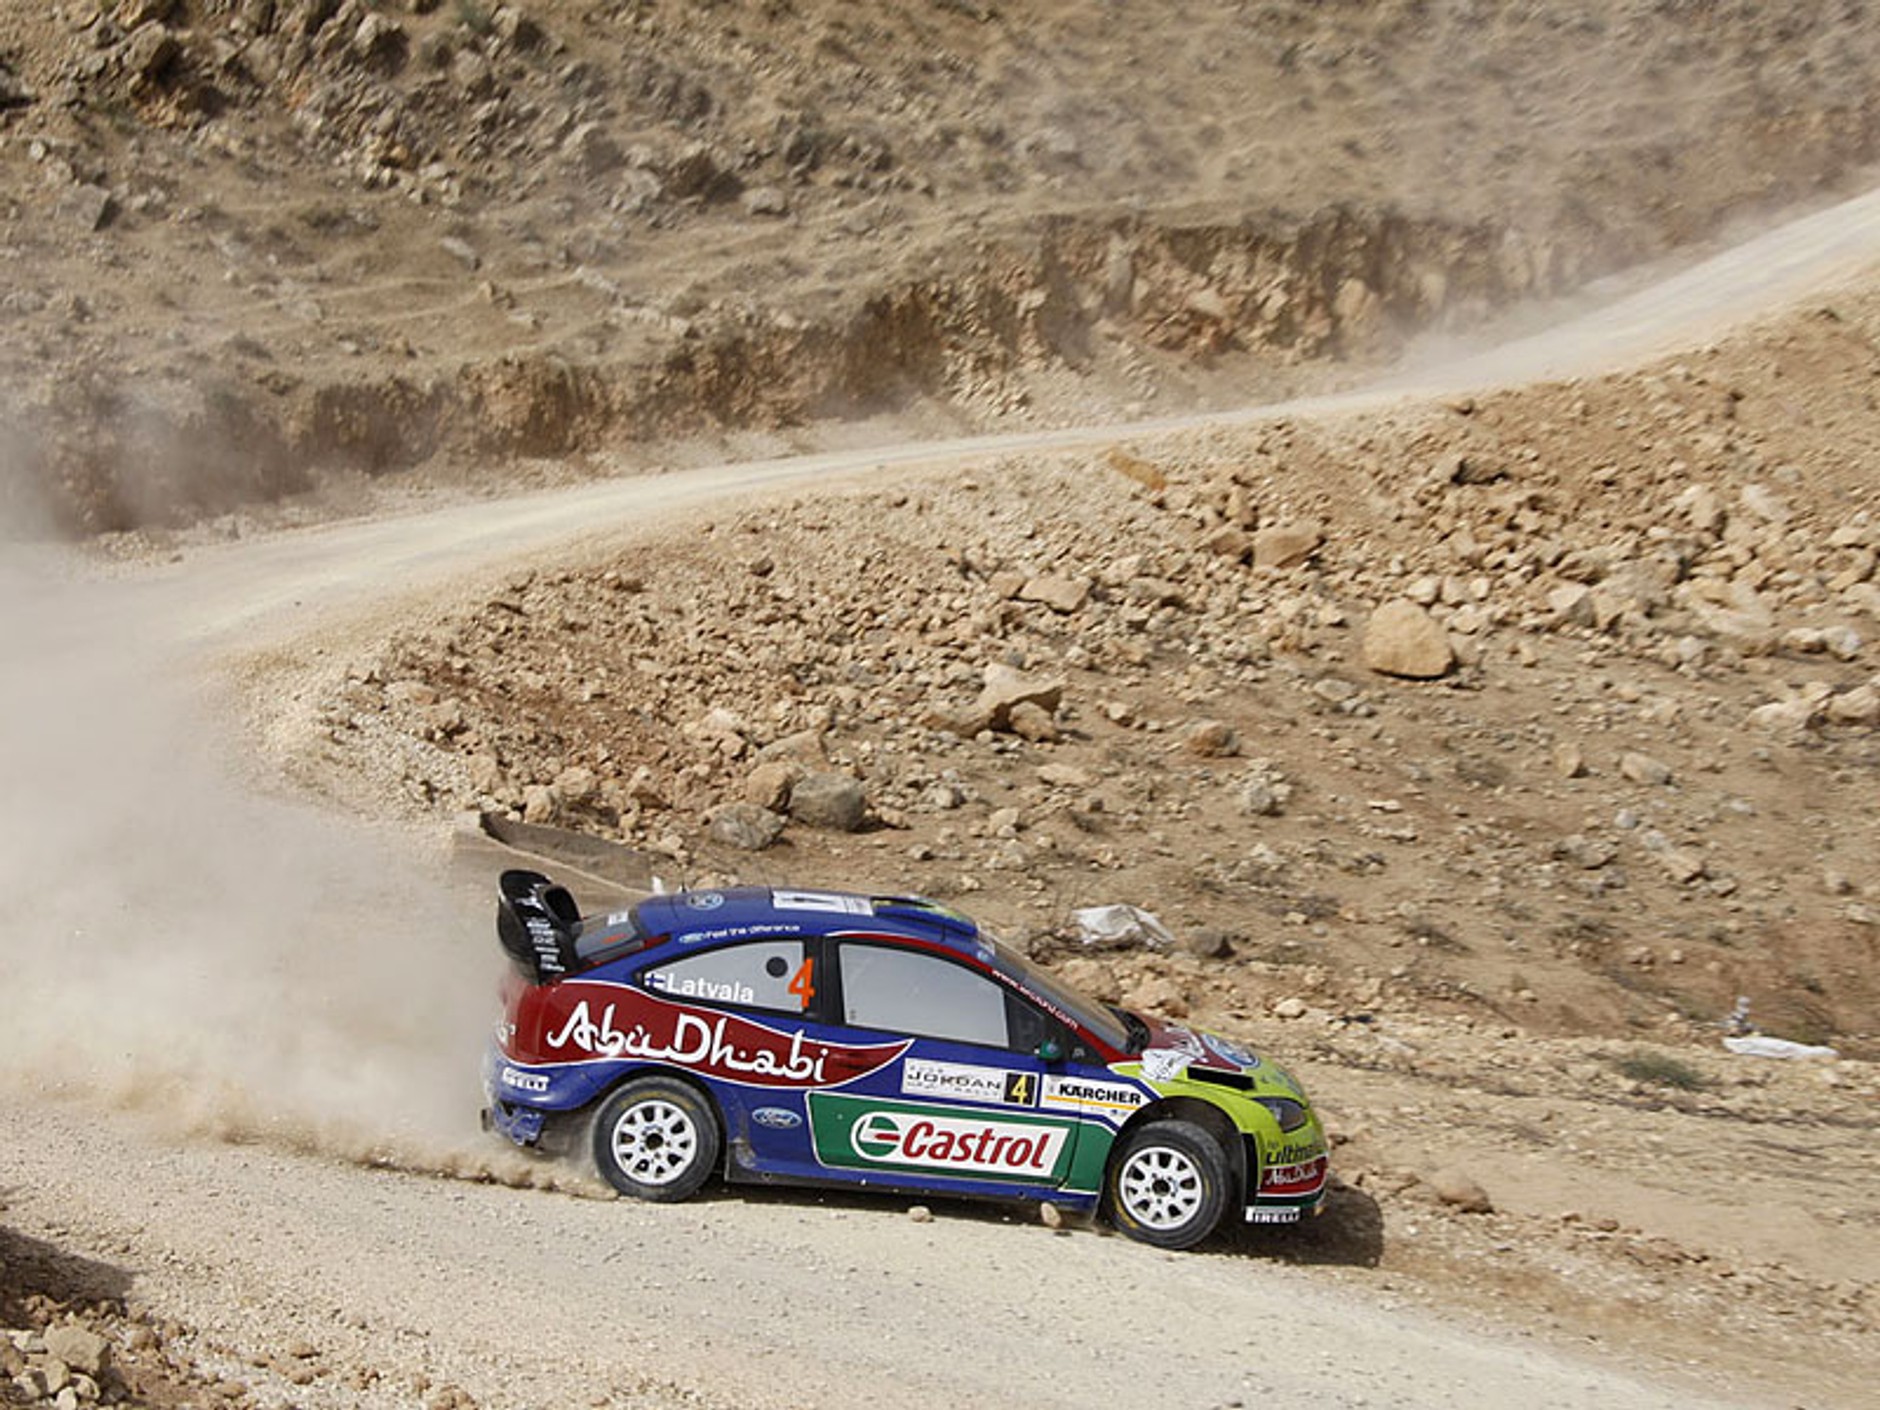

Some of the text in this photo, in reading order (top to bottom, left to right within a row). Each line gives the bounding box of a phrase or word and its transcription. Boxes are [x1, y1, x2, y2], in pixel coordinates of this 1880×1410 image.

[667, 973, 754, 1003] Latvala
[788, 958, 815, 1008] 4
[547, 1000, 829, 1082] Abu Dhabi
[907, 1071, 1001, 1091] JORDAN
[1009, 1076, 1028, 1105] 4
[902, 1121, 1050, 1168] Castrol
